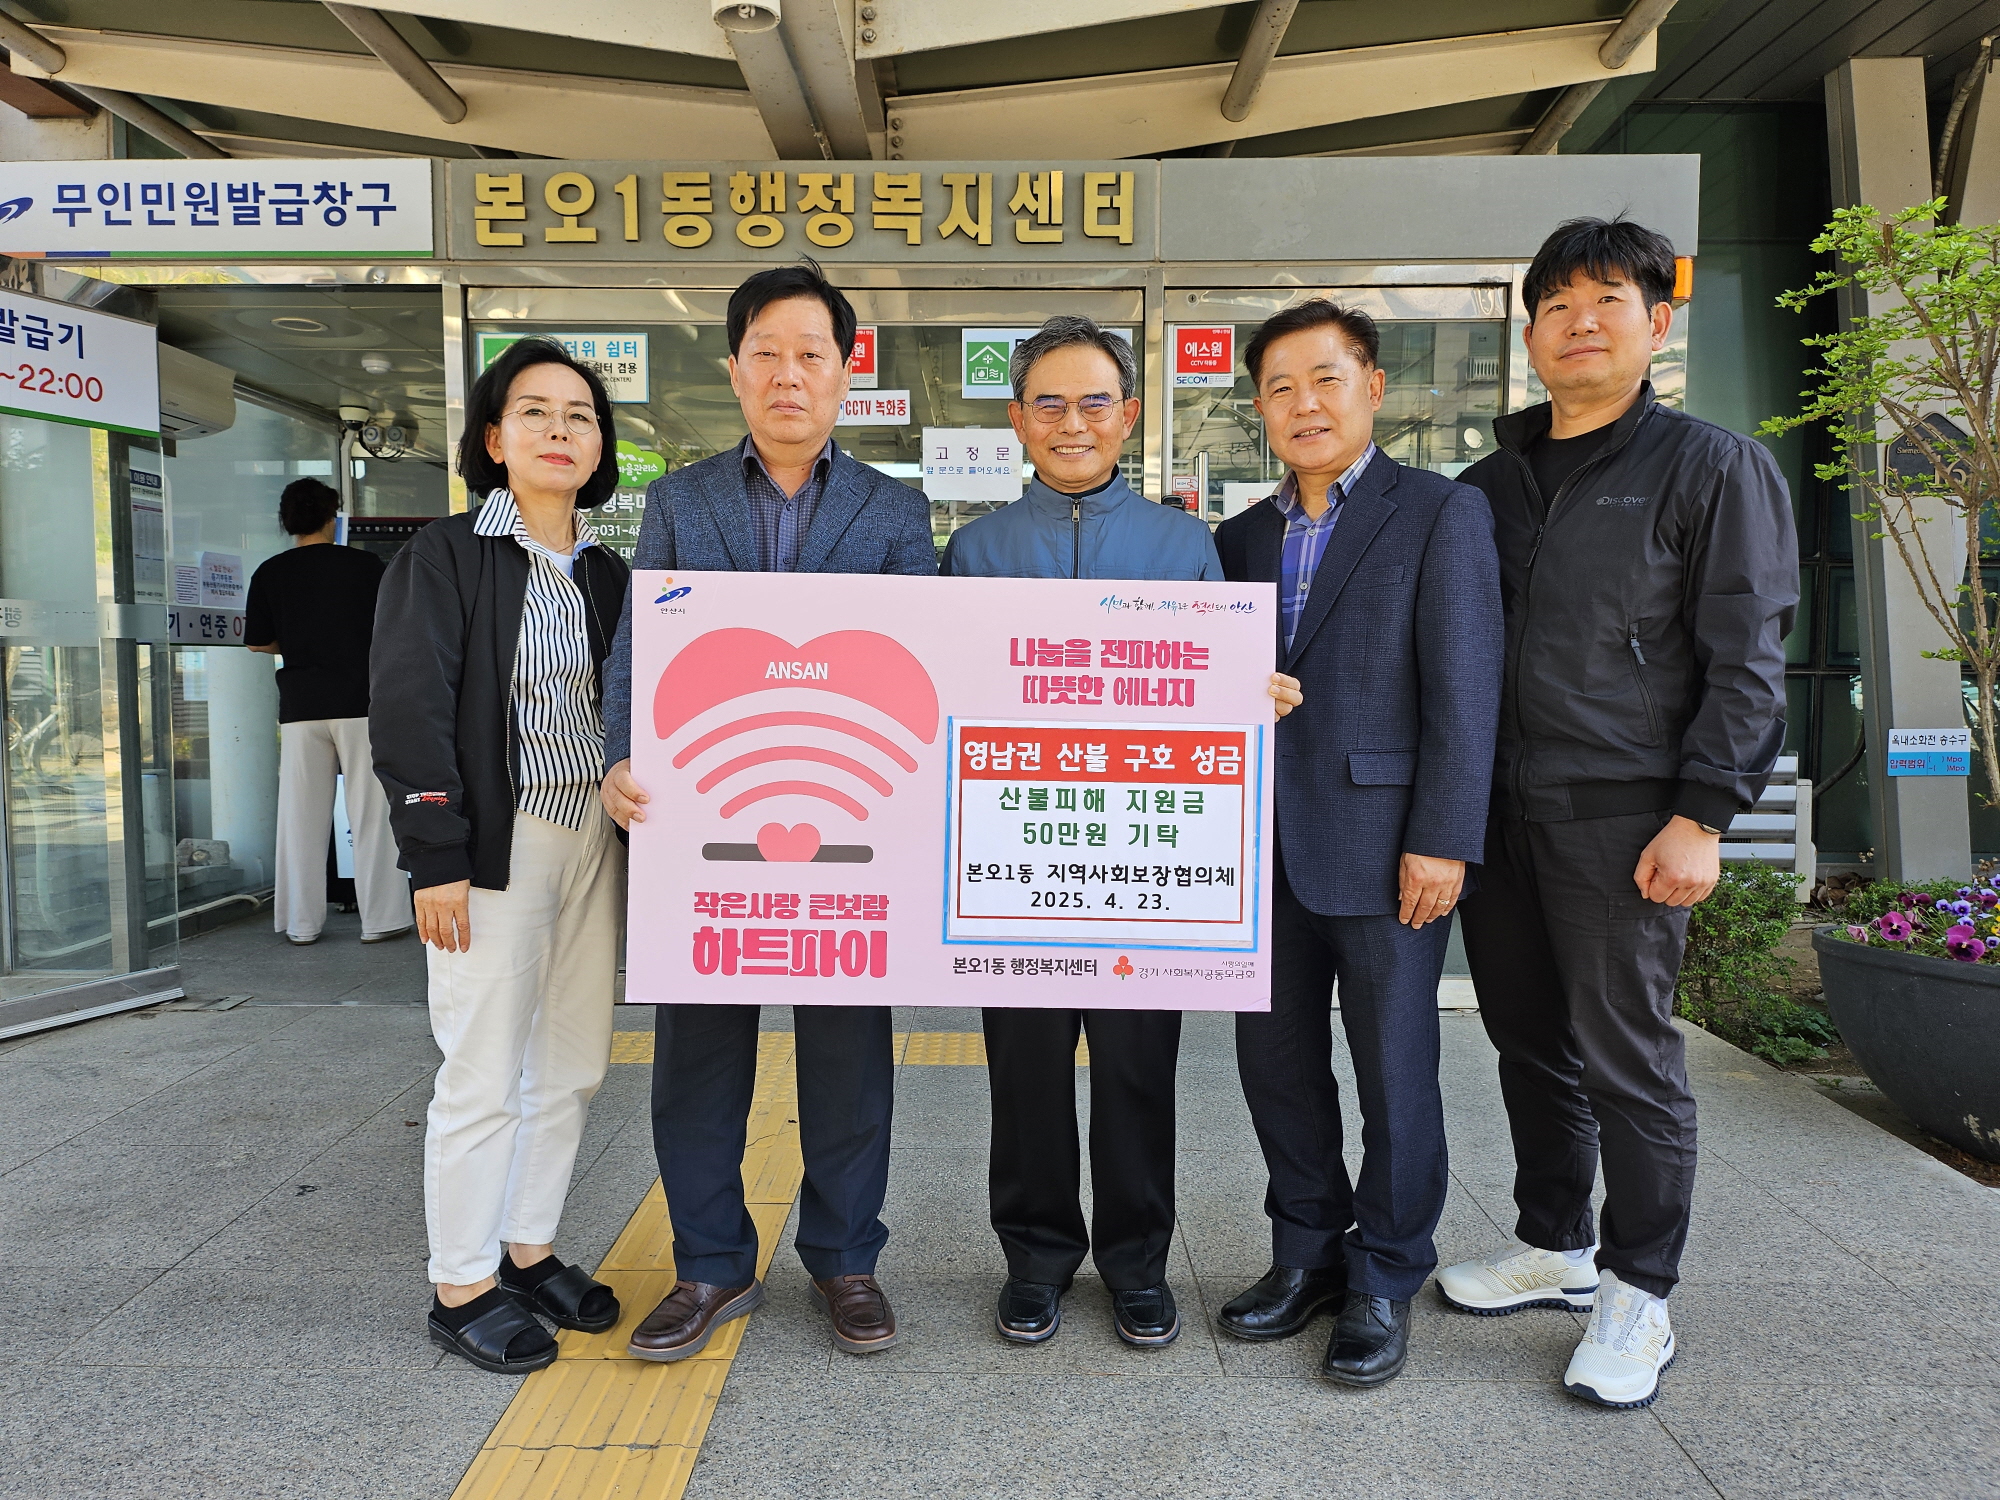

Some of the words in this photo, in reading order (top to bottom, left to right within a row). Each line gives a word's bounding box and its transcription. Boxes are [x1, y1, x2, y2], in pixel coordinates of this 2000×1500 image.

[52, 181, 397, 228] 무인민원발급창구
[475, 171, 1134, 247] 본오1동행정복지센터
[606, 341, 637, 358] 쉼터
[1185, 342, 1223, 357] 에스원
[617, 362, 638, 374] 겸용
[1176, 376, 1208, 384] SECOM
[845, 400, 871, 416] CCTV
[876, 400, 906, 416] 녹화중
[939, 466, 963, 475] 문으로
[968, 466, 1010, 475] 들어오세요
[660, 607, 686, 615] 안산시
[1100, 594, 1132, 614] 시민과
[1229, 601, 1257, 614] 안산
[200, 613, 228, 639] 연중
[1009, 637, 1092, 668] 나눔을
[1100, 639, 1210, 671] 전파하는
[764, 661, 829, 680] ANSAN
[1022, 674, 1105, 706] 따뜻한
[1113, 676, 1195, 708] 에너지
[1892, 735, 1936, 746] 옥내소화전
[1939, 735, 1967, 746] 송수구
[963, 740, 1042, 771] 영남권
[1056, 742, 1110, 773] 산불
[1123, 743, 1176, 773] 구호
[1190, 745, 1242, 776] 성금
[1890, 759, 1926, 769] 압력범위
[999, 786, 1106, 813] 산불피해
[1126, 789, 1205, 815] 지원금
[1023, 822, 1107, 847] 50만원
[1128, 823, 1180, 848] 기탁
[966, 863, 1035, 885] 본오1동
[1047, 864, 1235, 888] 지역사회보장협의체
[694, 891, 801, 920] 작은사랑
[809, 893, 889, 921] 큰보람
[1031, 891, 1091, 909] 2025.
[1104, 893, 1124, 910] 4.
[1137, 893, 1170, 911] 23.
[693, 925, 888, 979] 하트파이
[953, 957, 1006, 976] 본오1동
[1010, 958, 1098, 977] 행정복지센터
[1138, 967, 1159, 979] 경기
[1163, 968, 1256, 980] 사회복지공동모금회
